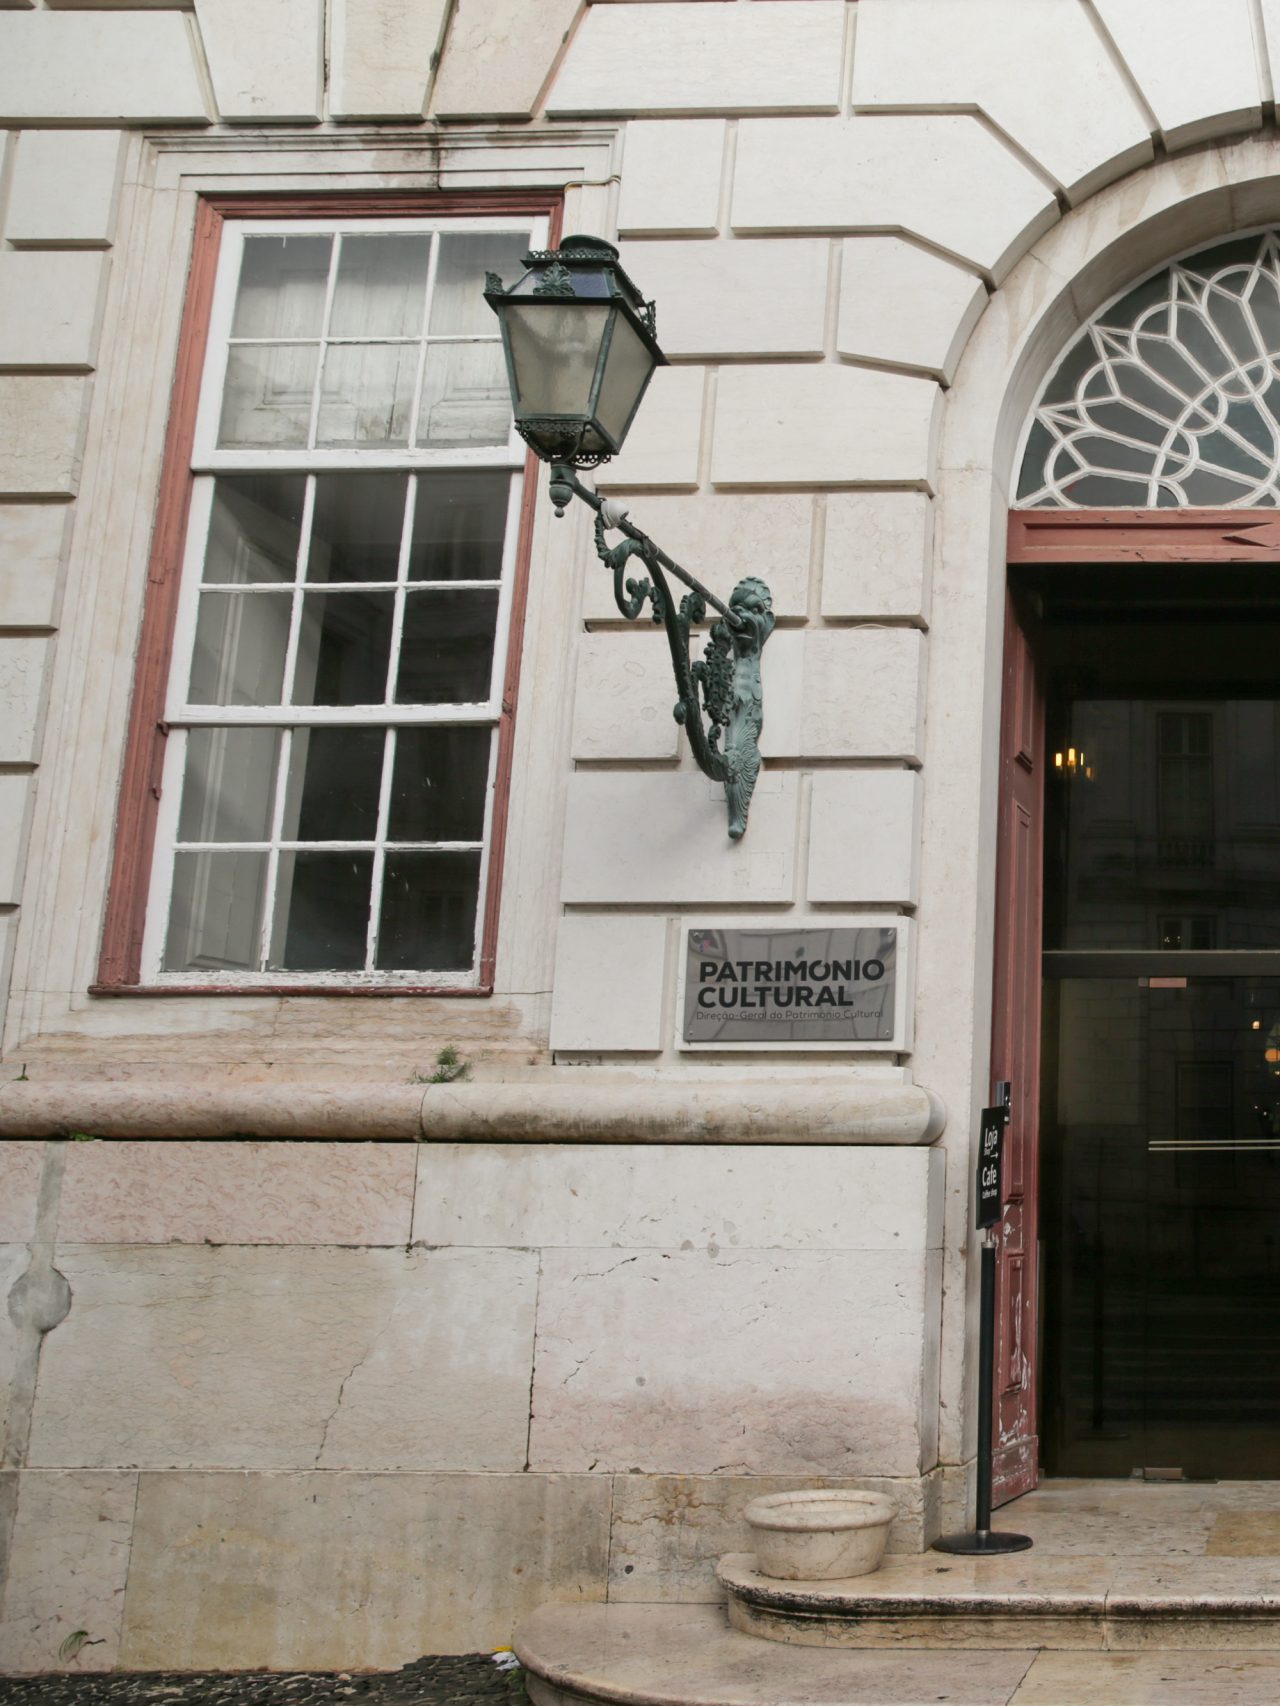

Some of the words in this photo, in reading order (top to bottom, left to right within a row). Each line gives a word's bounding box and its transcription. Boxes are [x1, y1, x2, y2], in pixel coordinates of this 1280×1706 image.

[697, 985, 854, 1008] CULTURAL
[769, 1010, 783, 1020] do
[843, 1008, 883, 1019] Cultural
[984, 1125, 998, 1150] Loja
